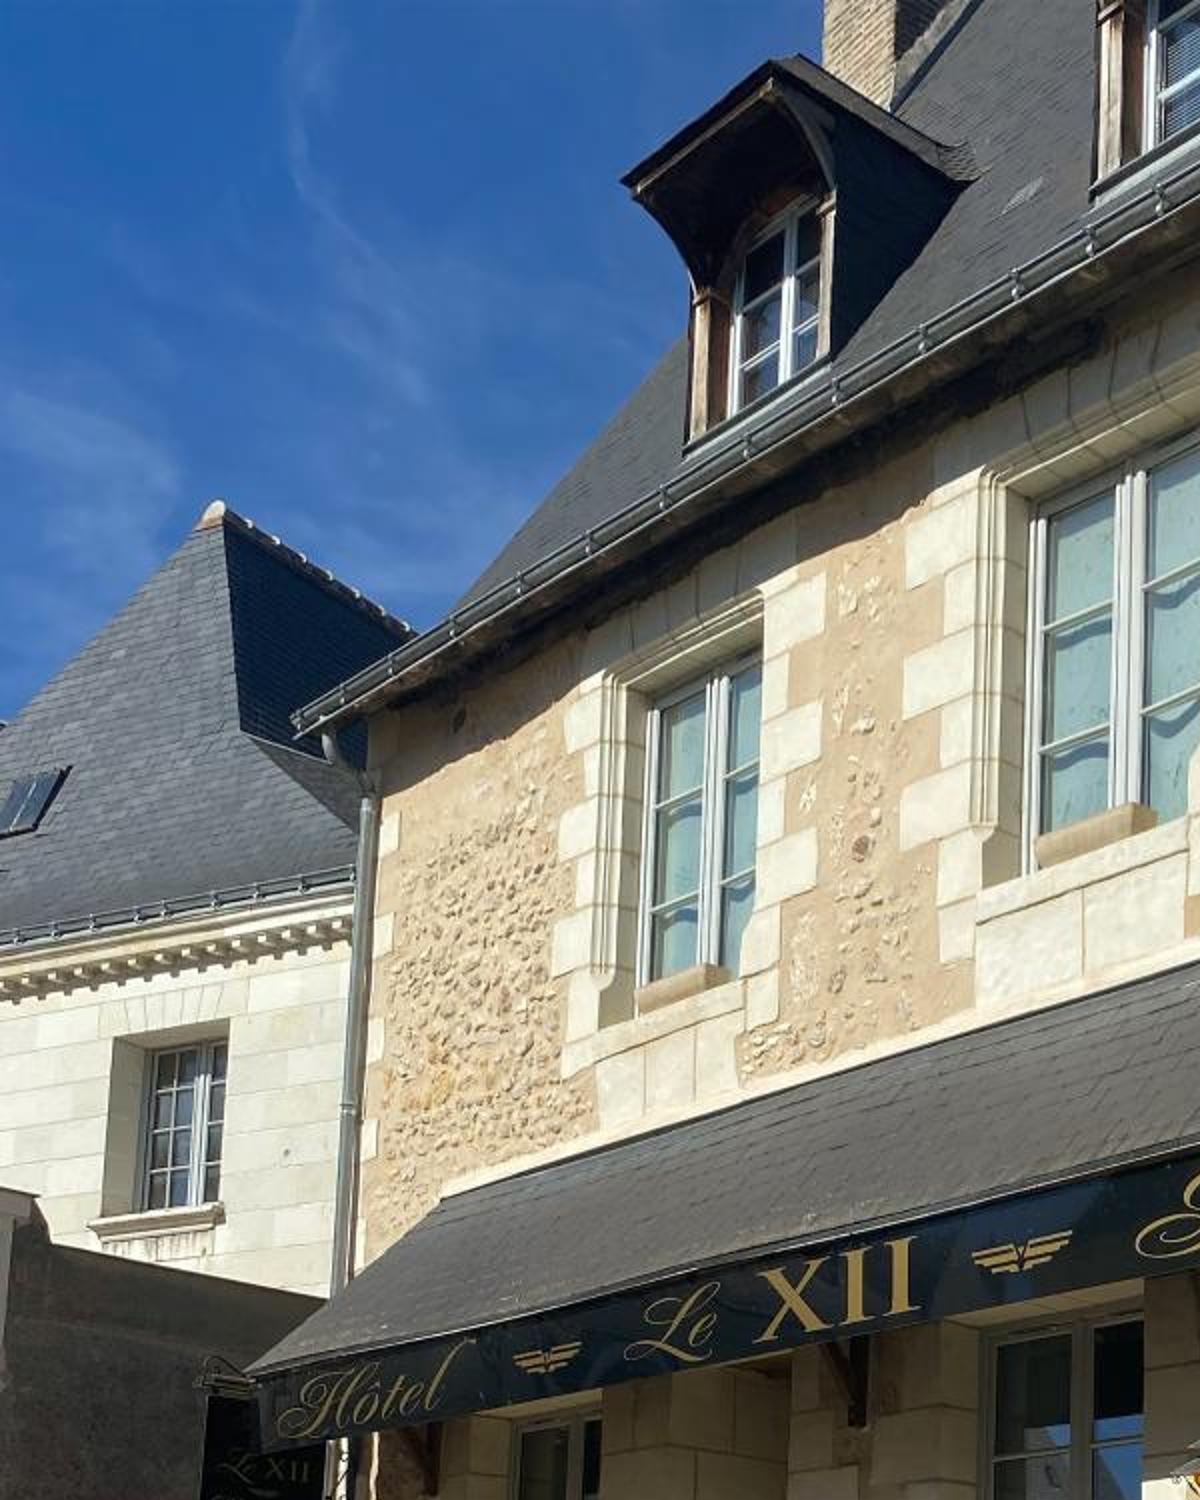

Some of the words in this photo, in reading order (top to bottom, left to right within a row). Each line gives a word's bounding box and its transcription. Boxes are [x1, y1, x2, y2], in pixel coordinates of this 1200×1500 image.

[278, 1336, 477, 1439] Hôtel
[623, 1281, 721, 1361] Le
[752, 1235, 922, 1344] XII
[264, 1457, 311, 1485] XII
